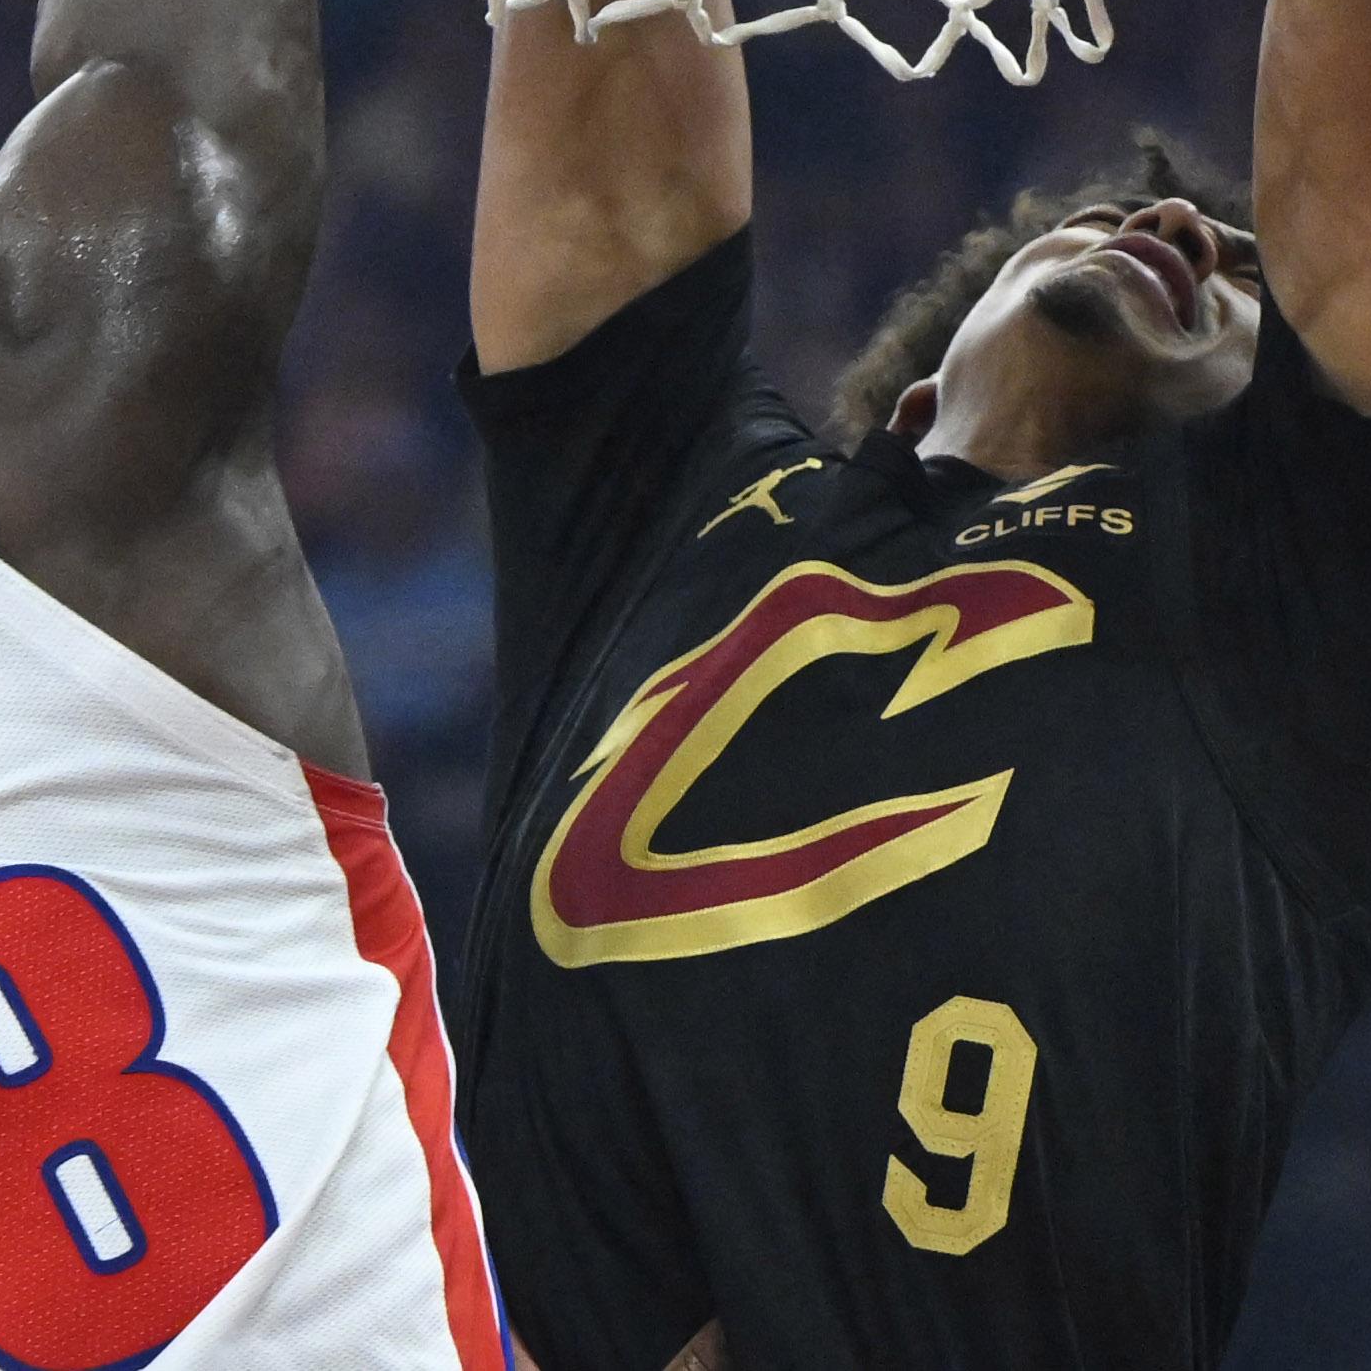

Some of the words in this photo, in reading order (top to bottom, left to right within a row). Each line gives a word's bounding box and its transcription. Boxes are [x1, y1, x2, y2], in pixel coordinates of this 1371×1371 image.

[955, 504, 1134, 546] CLIFFS
[529, 560, 1095, 969] C
[881, 994, 1039, 1256] 9
